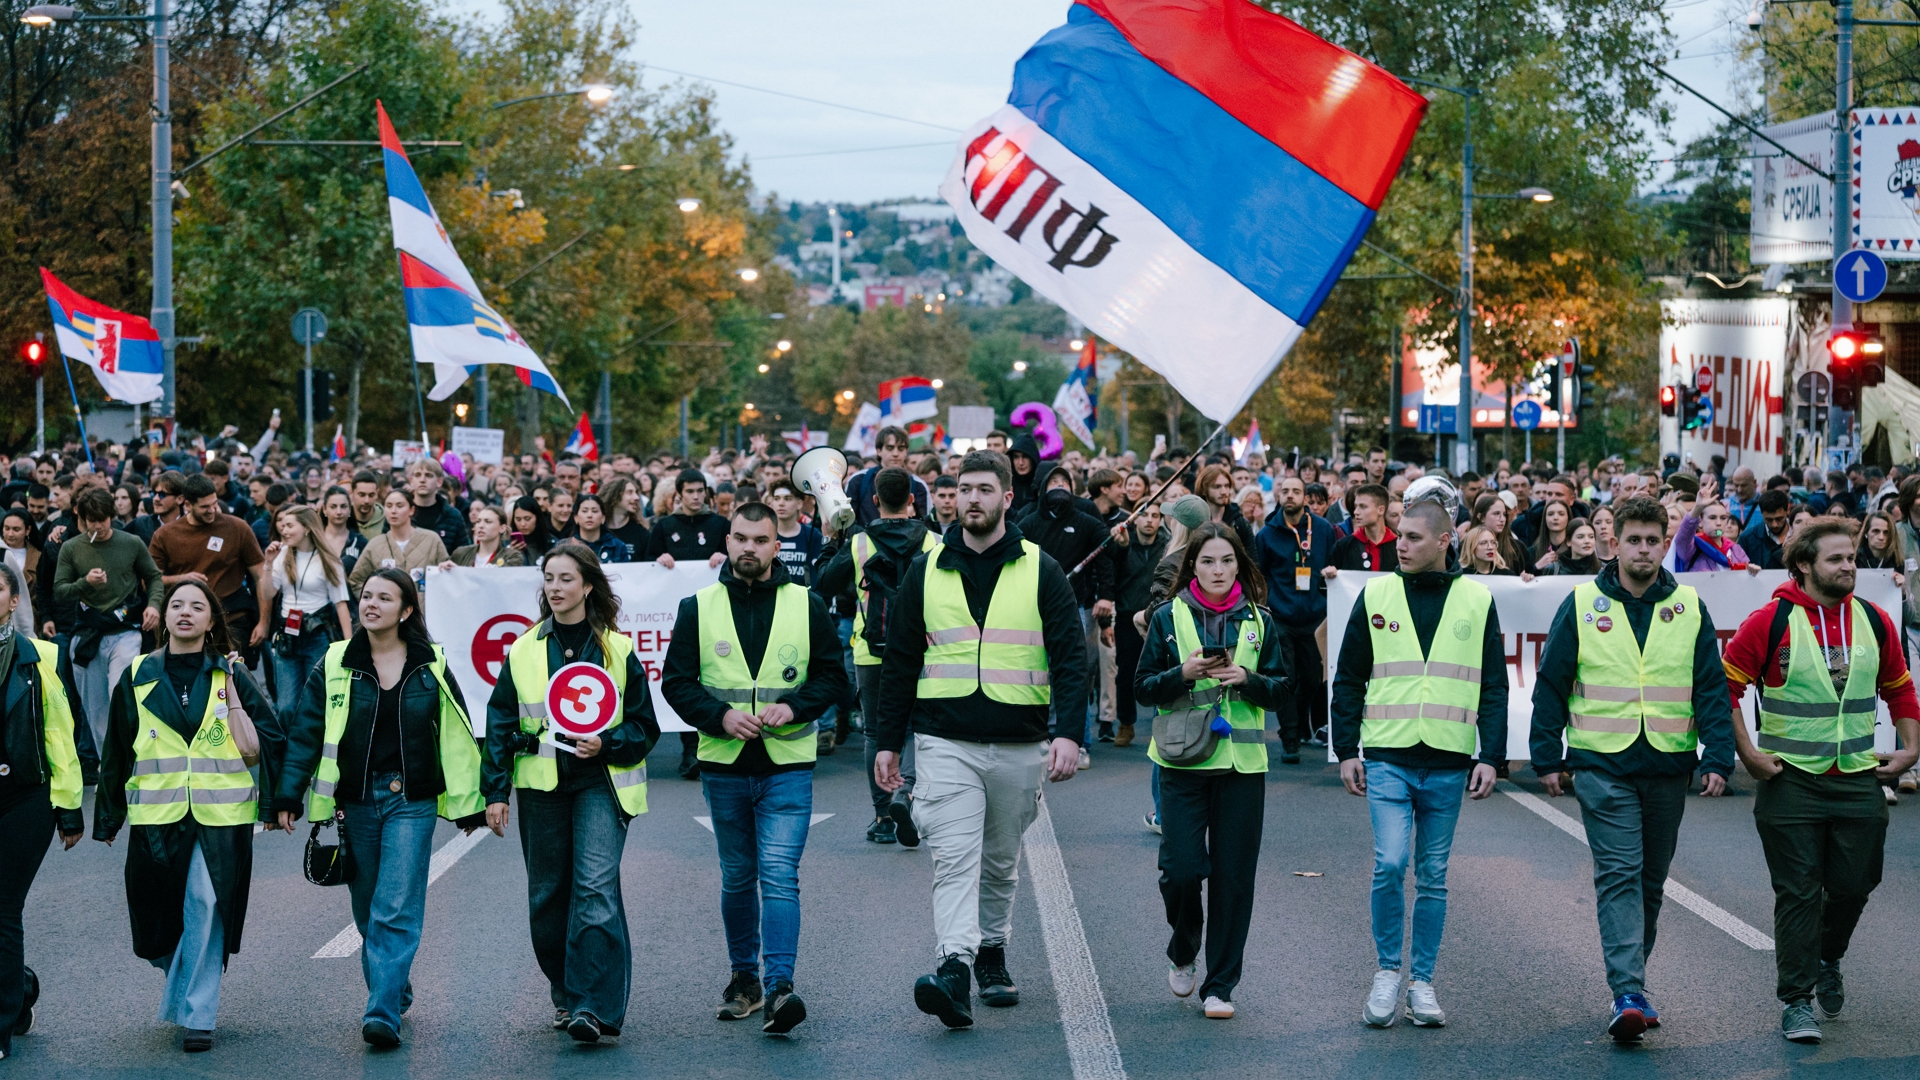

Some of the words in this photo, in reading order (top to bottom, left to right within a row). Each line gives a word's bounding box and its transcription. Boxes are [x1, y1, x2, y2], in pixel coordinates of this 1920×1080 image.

[1783, 183, 1822, 222] СРБИЈА
[1698, 374, 1712, 386] STOP
[1010, 401, 1064, 460] 3
[1676, 603, 1684, 613] 3
[635, 612, 675, 623] ЛИСТА
[1585, 613, 1593, 622] 3
[1391, 621, 1398, 631] 3
[220, 689, 227, 699] 3
[560, 674, 606, 726] 3
[150, 729, 157, 739] 3
